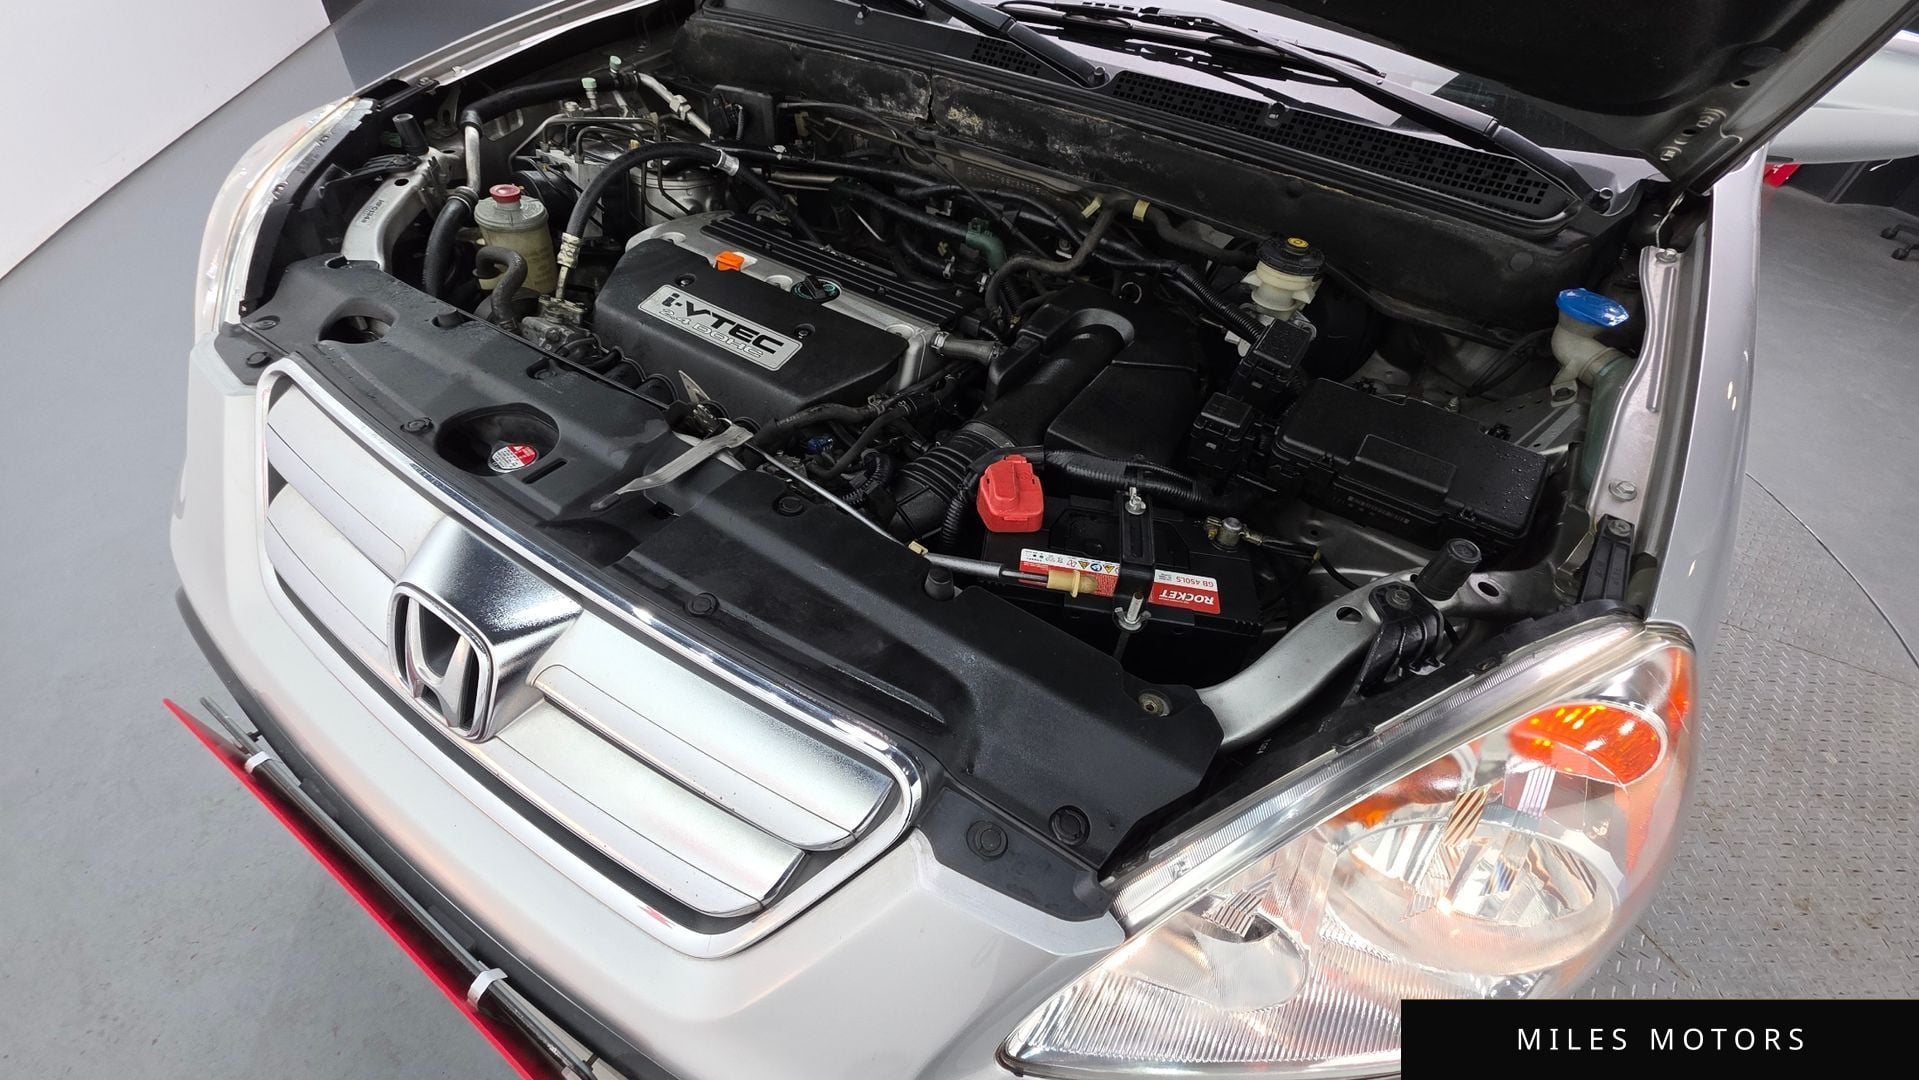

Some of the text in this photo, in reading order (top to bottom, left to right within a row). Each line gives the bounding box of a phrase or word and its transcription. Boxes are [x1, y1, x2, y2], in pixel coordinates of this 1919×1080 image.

[662, 293, 785, 355] i-VTEC
[659, 308, 763, 359] 2.4 DOHC
[1176, 575, 1201, 585] 450LS
[1203, 580, 1214, 588] GB
[1159, 589, 1214, 605] ROCKET
